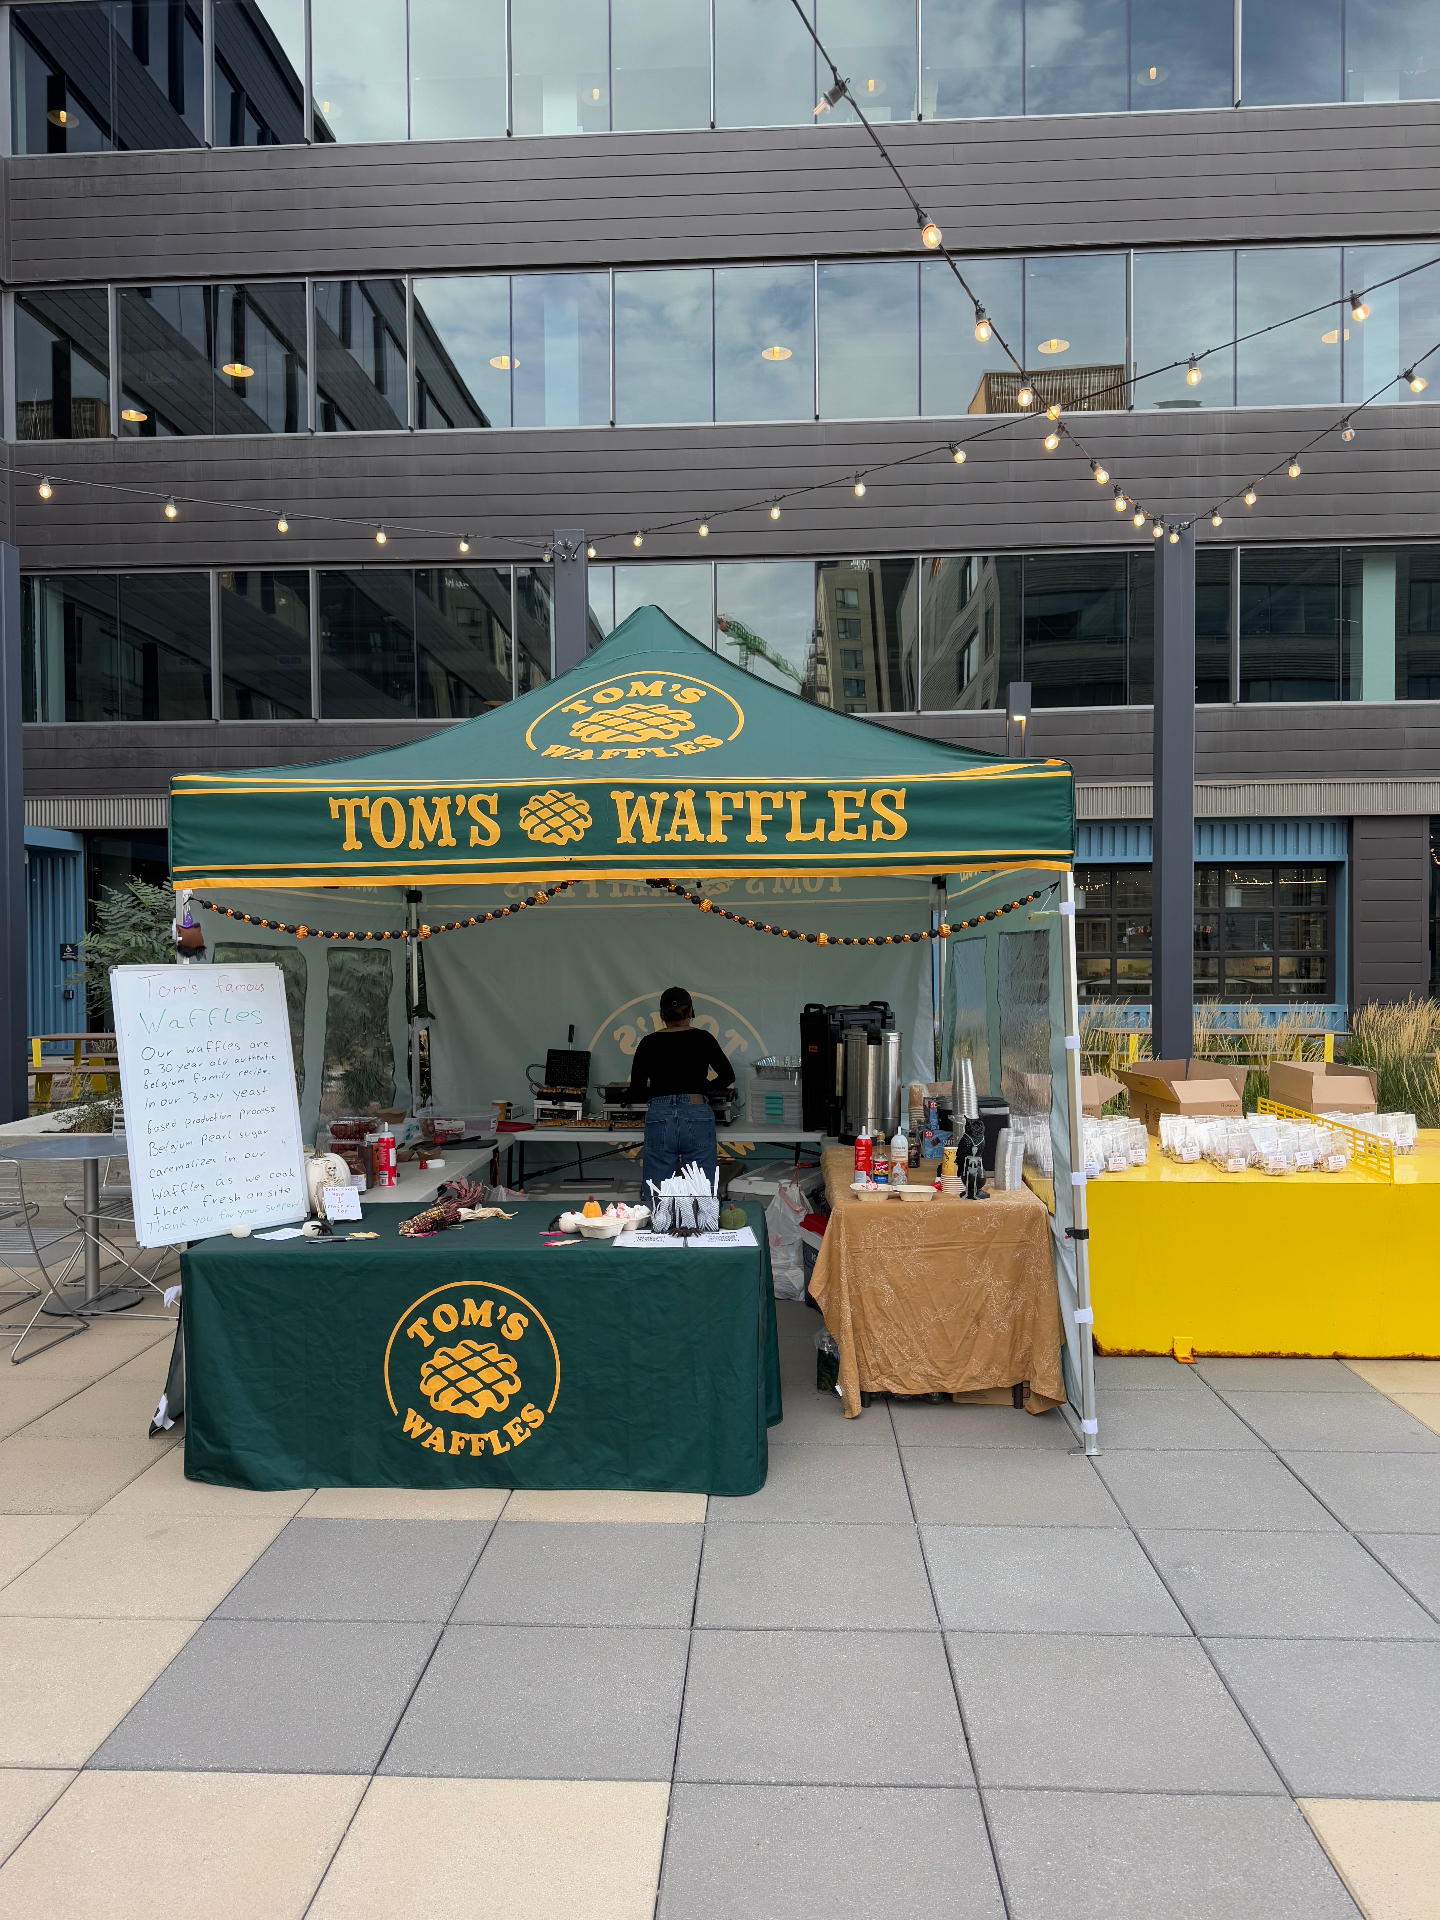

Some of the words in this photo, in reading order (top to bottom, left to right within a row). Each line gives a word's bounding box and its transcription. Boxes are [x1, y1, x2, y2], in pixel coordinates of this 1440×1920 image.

[561, 680, 707, 715] TOM'S
[540, 734, 724, 761] WAFFLES
[328, 792, 501, 852] TOM'S
[610, 788, 908, 844] WAFFLES
[138, 973, 199, 1002] Tom's
[215, 974, 266, 994] famous
[139, 1007, 264, 1034] Waffles
[141, 1046, 173, 1061] Our
[186, 1040, 241, 1054] waffles
[249, 1040, 270, 1049] are
[143, 1067, 152, 1076] a
[157, 1063, 173, 1074] 30
[176, 1061, 203, 1073] year
[209, 1056, 228, 1067] old
[193, 1071, 231, 1085] family
[160, 1096, 181, 1108] our
[188, 1091, 199, 1104] 3
[202, 1091, 224, 1103] day
[232, 1085, 269, 1102] yeast
[184, 1111, 232, 1129] production
[239, 1105, 277, 1120] process
[149, 1138, 193, 1157] Belgium
[201, 1129, 233, 1146] pearl
[239, 1128, 269, 1140] sugar
[244, 1149, 267, 1160] our
[151, 1181, 206, 1201] Waffles
[215, 1174, 233, 1187] as
[244, 1172, 261, 1183] we
[269, 1167, 296, 1179] cook
[153, 1203, 190, 1220] them
[203, 1193, 241, 1208] fresh
[246, 1189, 263, 1200] on
[267, 1184, 291, 1198] site
[146, 1216, 188, 1234] Thank
[193, 1214, 213, 1228] you
[218, 1208, 235, 1220] for
[237, 1206, 259, 1219] your
[406, 1298, 529, 1348] TOM'S
[402, 1402, 545, 1457] WAFFLES
